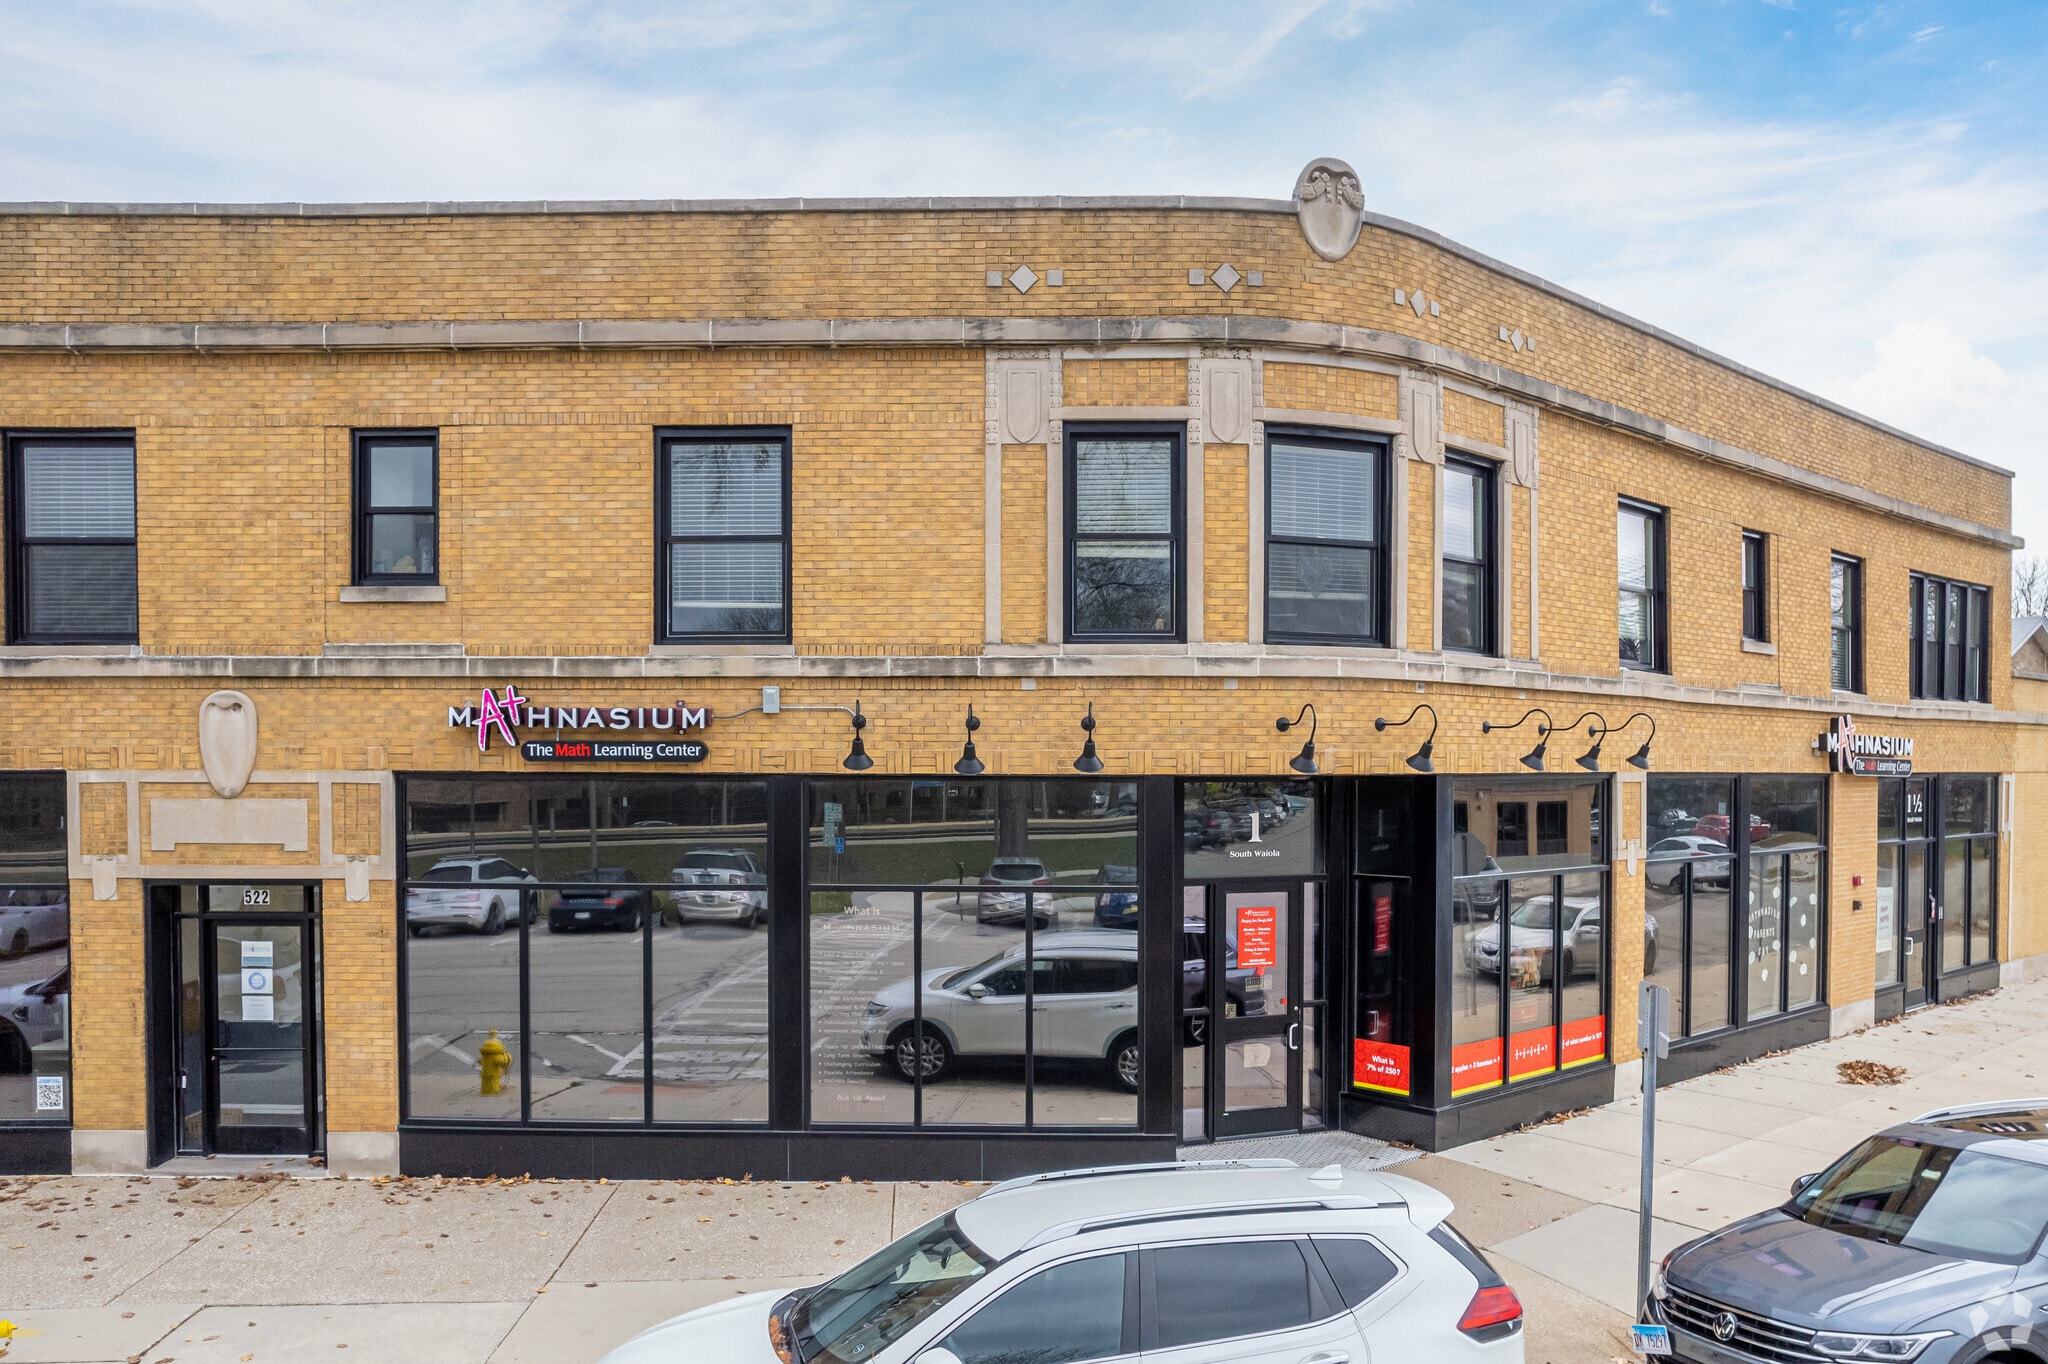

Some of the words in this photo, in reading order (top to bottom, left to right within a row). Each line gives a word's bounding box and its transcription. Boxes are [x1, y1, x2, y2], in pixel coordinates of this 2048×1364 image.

[527, 743, 553, 757] The
[555, 744, 591, 757] Math
[594, 743, 654, 760] Learning
[656, 743, 701, 757] Center
[1855, 760, 1865, 771] The
[1877, 761, 1897, 775] Learning
[1897, 761, 1912, 772] Center
[1248, 812, 1263, 843] 1
[1229, 850, 1252, 858] South
[244, 890, 269, 904] 522
[844, 906, 872, 915] What
[873, 906, 881, 915] is
[1371, 1055, 1388, 1065] What
